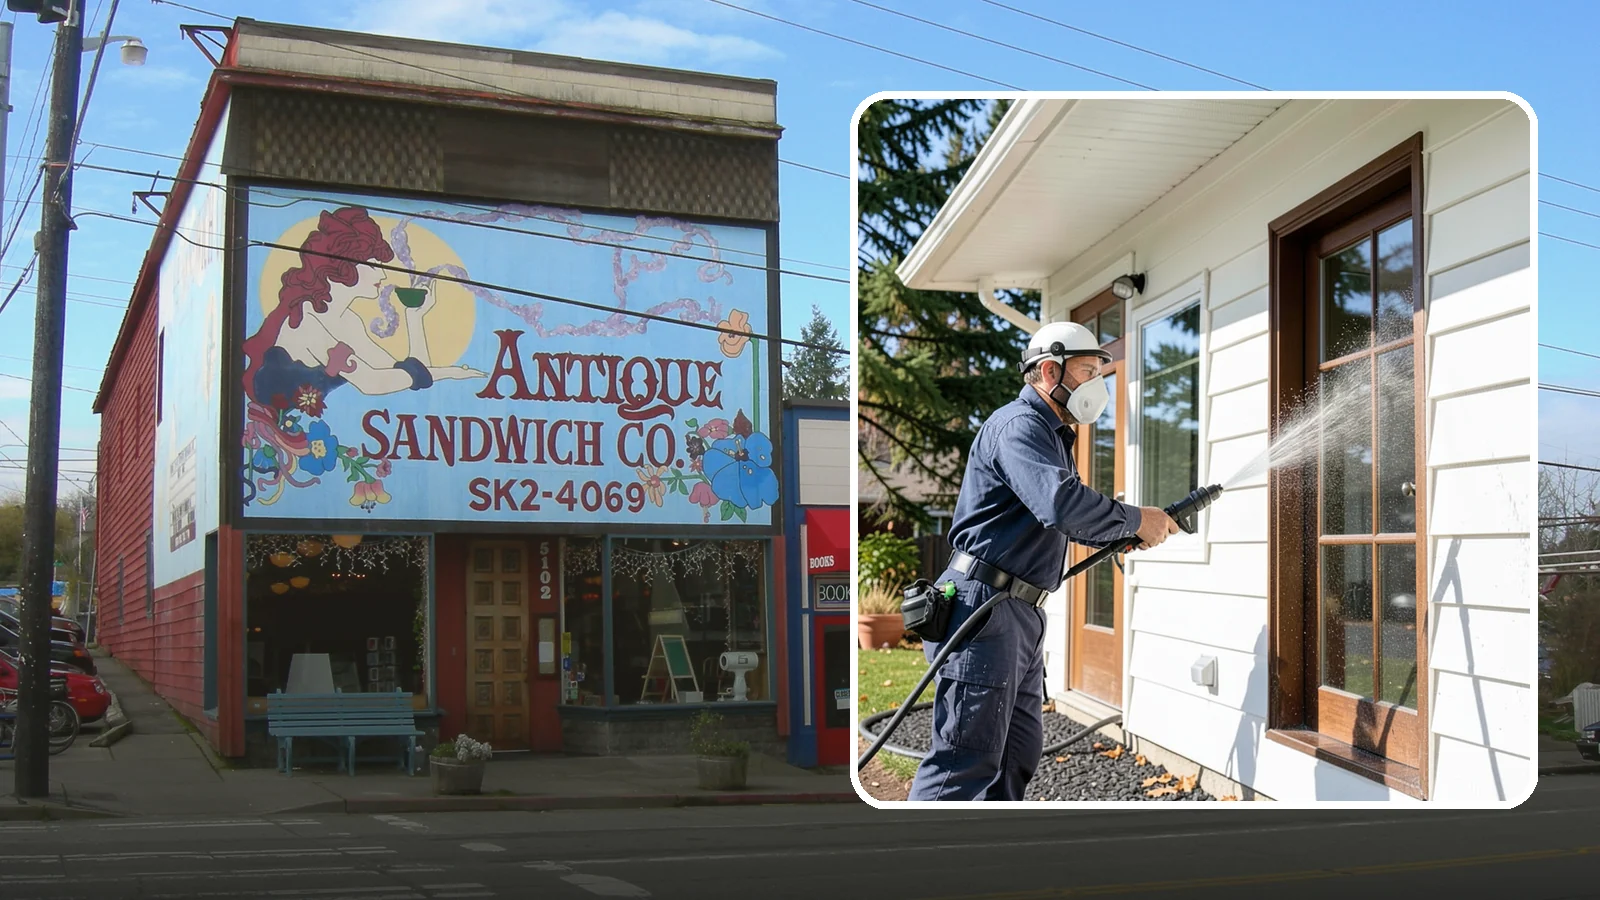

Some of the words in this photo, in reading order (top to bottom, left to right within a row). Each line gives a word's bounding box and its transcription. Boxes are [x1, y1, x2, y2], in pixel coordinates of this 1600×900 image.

[476, 329, 723, 420] ANTIQUE
[362, 408, 605, 468] SANDWICH
[617, 420, 686, 470] CO.
[469, 476, 646, 513] SK2-4069
[540, 541, 551, 599] 5102
[810, 555, 834, 568] BOOKS
